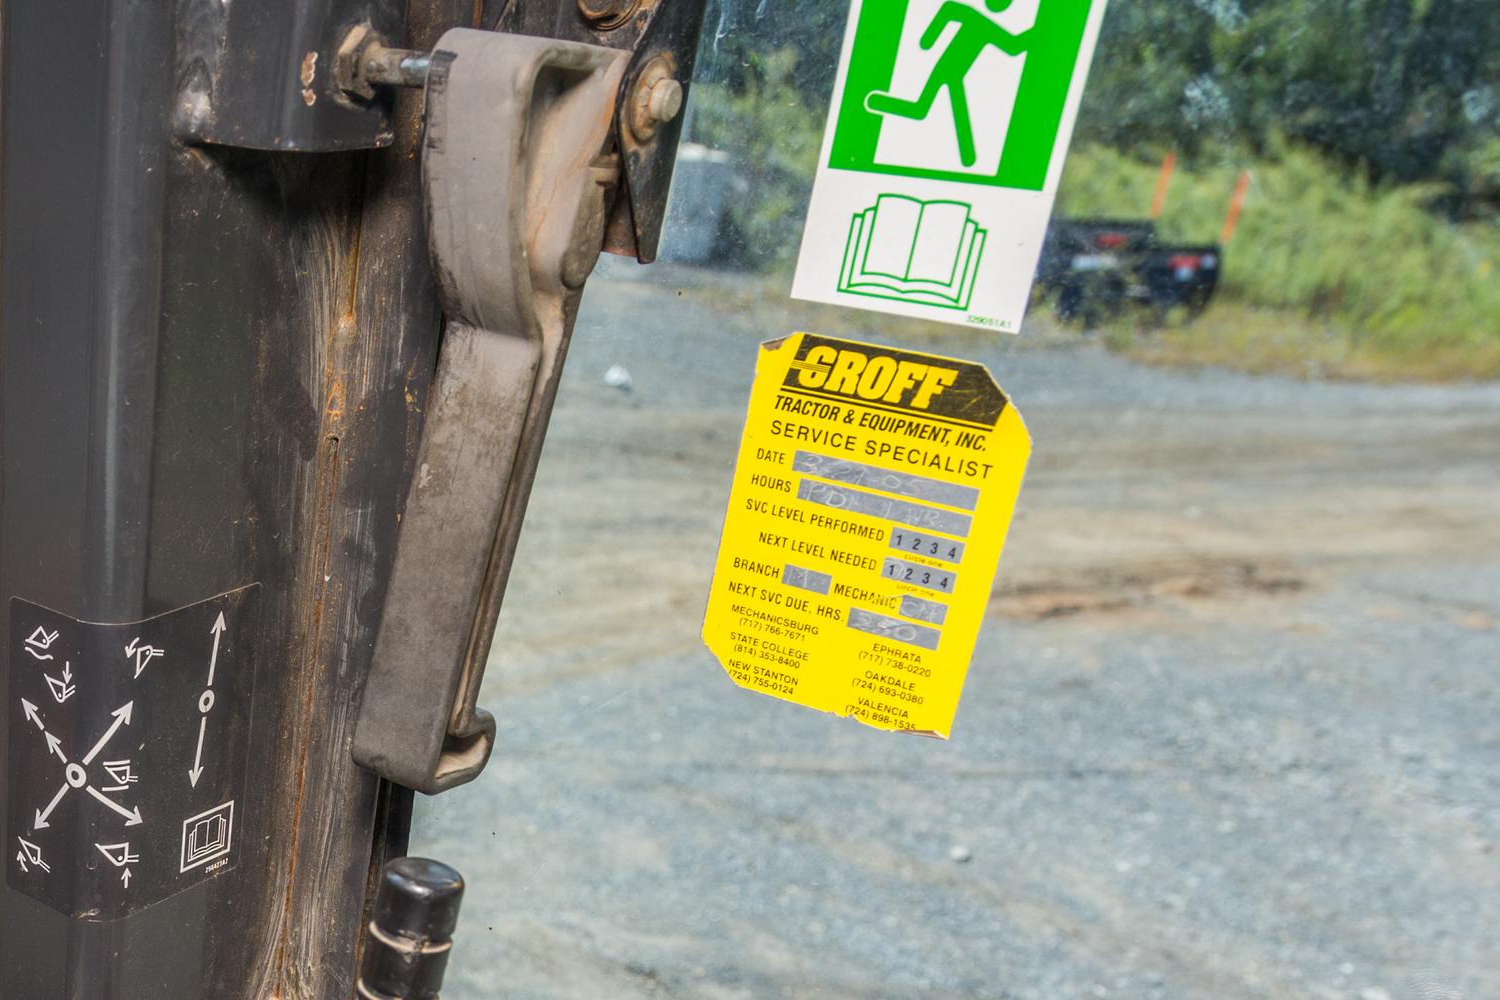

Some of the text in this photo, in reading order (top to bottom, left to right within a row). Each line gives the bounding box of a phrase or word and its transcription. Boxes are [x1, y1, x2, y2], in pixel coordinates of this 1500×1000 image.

[796, 345, 959, 410] GROFF
[774, 394, 987, 452] TRACTOR & EQUIPMENT, INC.
[756, 448, 786, 465] DATE
[770, 420, 994, 480] SERVICE SPECIALIST
[751, 474, 792, 493] HOURS
[746, 498, 885, 542] SVC LEVEL PERFORMED
[759, 531, 878, 572] NEXT LEVEL NEEDED
[895, 534, 957, 559] 1 2 3 4
[733, 556, 780, 579] BRANCH
[888, 564, 949, 589] 1 2 3 4
[728, 580, 757, 598] NEXT
[760, 588, 783, 605] SVC
[833, 582, 898, 610] MECHANIC
[731, 603, 819, 636] MECHANICSBURG
[739, 616, 805, 642] (717) 766-7671
[730, 631, 810, 661] STATE COLLEGE
[733, 643, 801, 669] (814) 353-8400
[872, 642, 922, 663] EPHRATA
[728, 658, 799, 686] NEW STANTON
[858, 650, 932, 678] (717) 738-0220
[753, 676, 795, 695] 755-0124
[851, 677, 924, 705] (724) 693-0380
[865, 670, 917, 692] OAKDALE
[845, 703, 870, 719] (724)
[857, 696, 909, 718] VALENCIA
